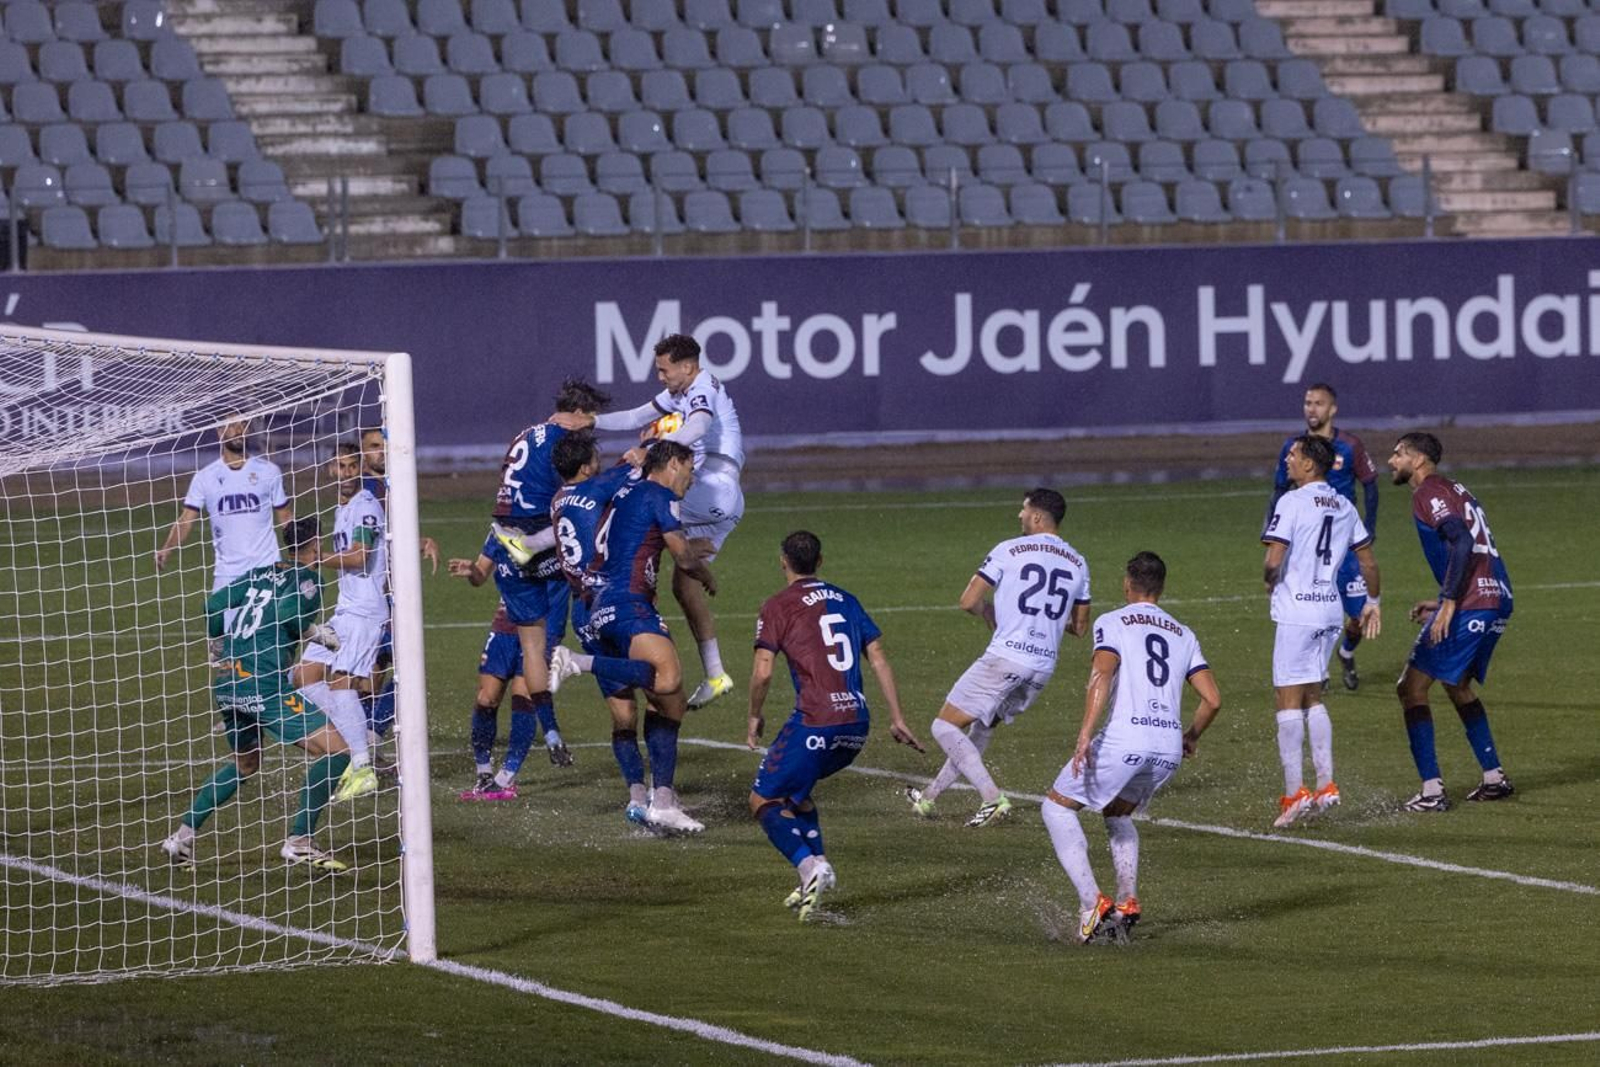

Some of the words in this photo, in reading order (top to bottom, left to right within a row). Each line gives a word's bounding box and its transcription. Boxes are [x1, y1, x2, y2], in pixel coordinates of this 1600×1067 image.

[595, 300, 896, 383] Motor
[919, 282, 1166, 376] Jaén
[1197, 269, 1600, 384] Hyundai
[504, 440, 529, 489] 2
[557, 517, 583, 566] 8
[1009, 543, 1039, 557] PEDRO
[1315, 515, 1335, 566] 4
[1017, 562, 1074, 621] 25
[818, 613, 854, 671] 5
[1121, 613, 1183, 637] CABALLERO
[1145, 633, 1170, 687] 8
[830, 692, 857, 702] ELDA
